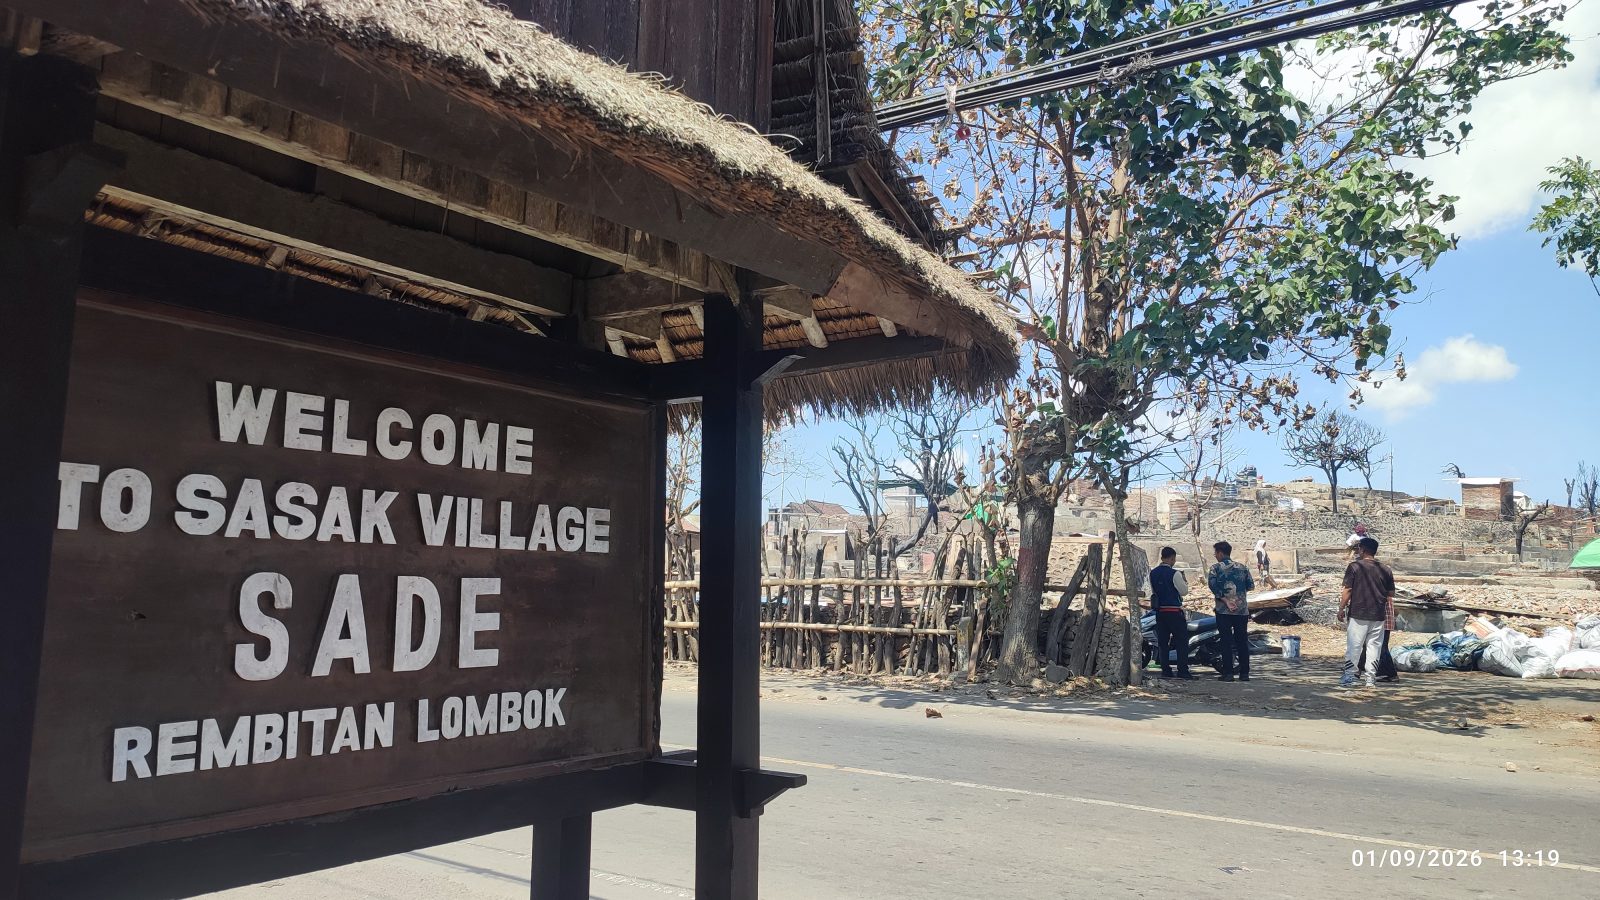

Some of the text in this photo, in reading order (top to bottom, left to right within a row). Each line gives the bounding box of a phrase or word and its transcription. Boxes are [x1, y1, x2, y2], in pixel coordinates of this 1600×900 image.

[214, 380, 534, 475] WELCOME
[57, 461, 611, 554] TO SASAK VILLAGE
[234, 571, 502, 681] SADE
[111, 687, 567, 783] REMBITAN LOMBOK
